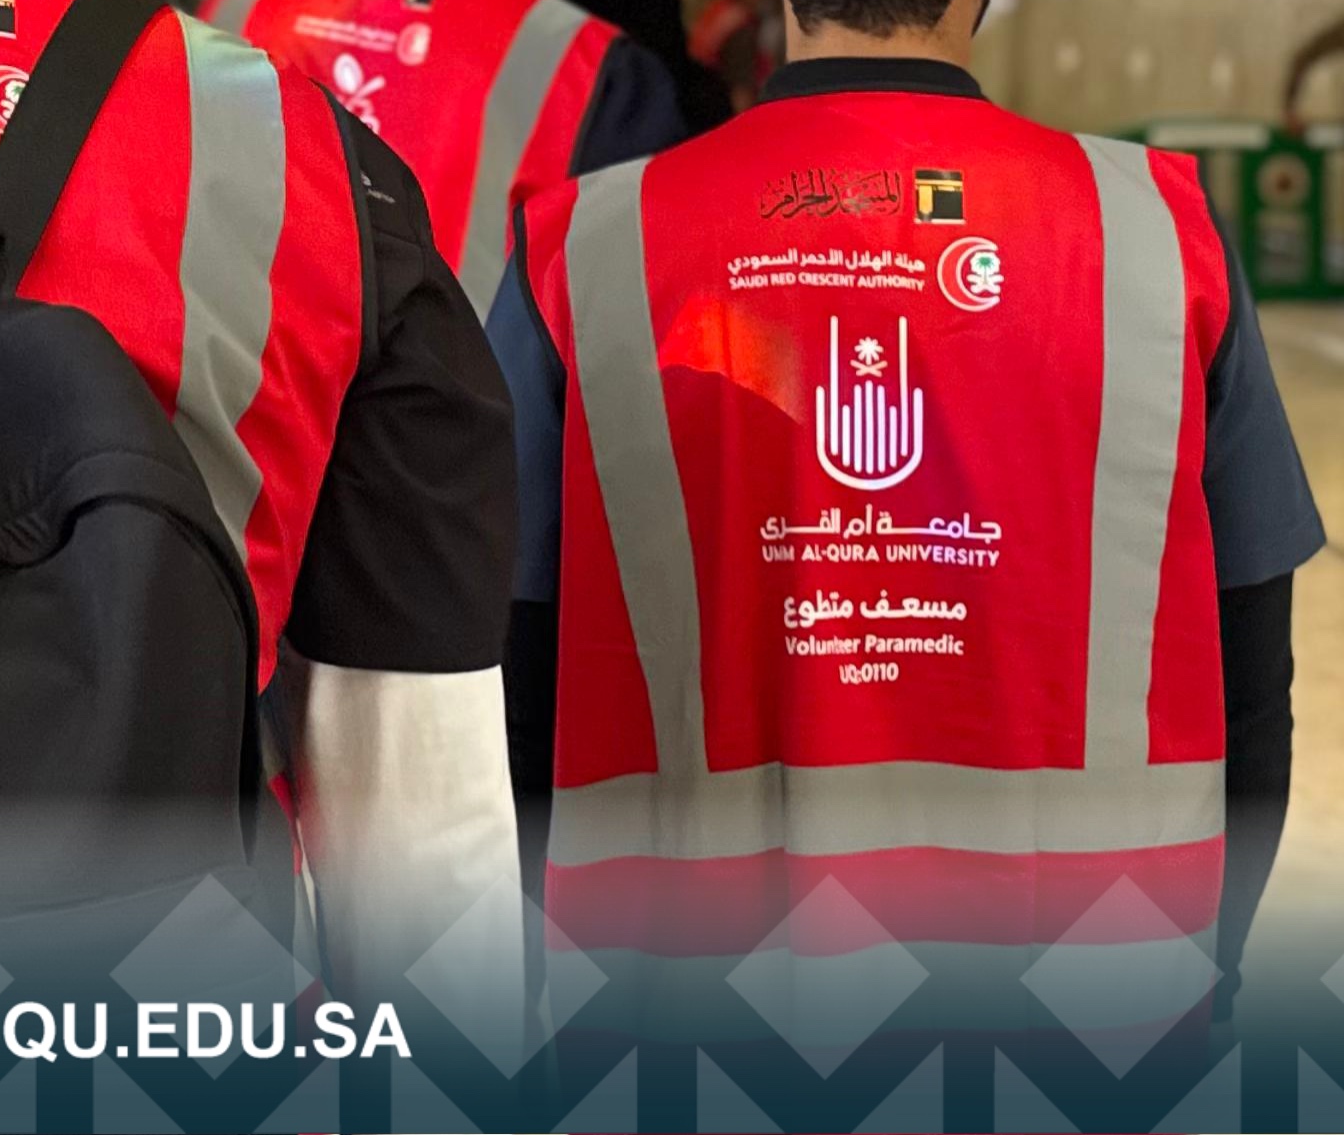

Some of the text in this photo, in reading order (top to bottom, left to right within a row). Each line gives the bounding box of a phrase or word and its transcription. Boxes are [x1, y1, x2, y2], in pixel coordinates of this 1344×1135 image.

[727, 248, 798, 275] السعودي
[845, 249, 892, 271] الهلال
[729, 271, 926, 292] SAUDI RED CRESCENT AUTHORITY
[760, 503, 1003, 544] جامعة أم القرى
[762, 544, 1000, 568] UMM AL-QURA UNIVERSITY
[783, 589, 968, 629] مسعف متطوع
[864, 634, 965, 656] Paramedic
